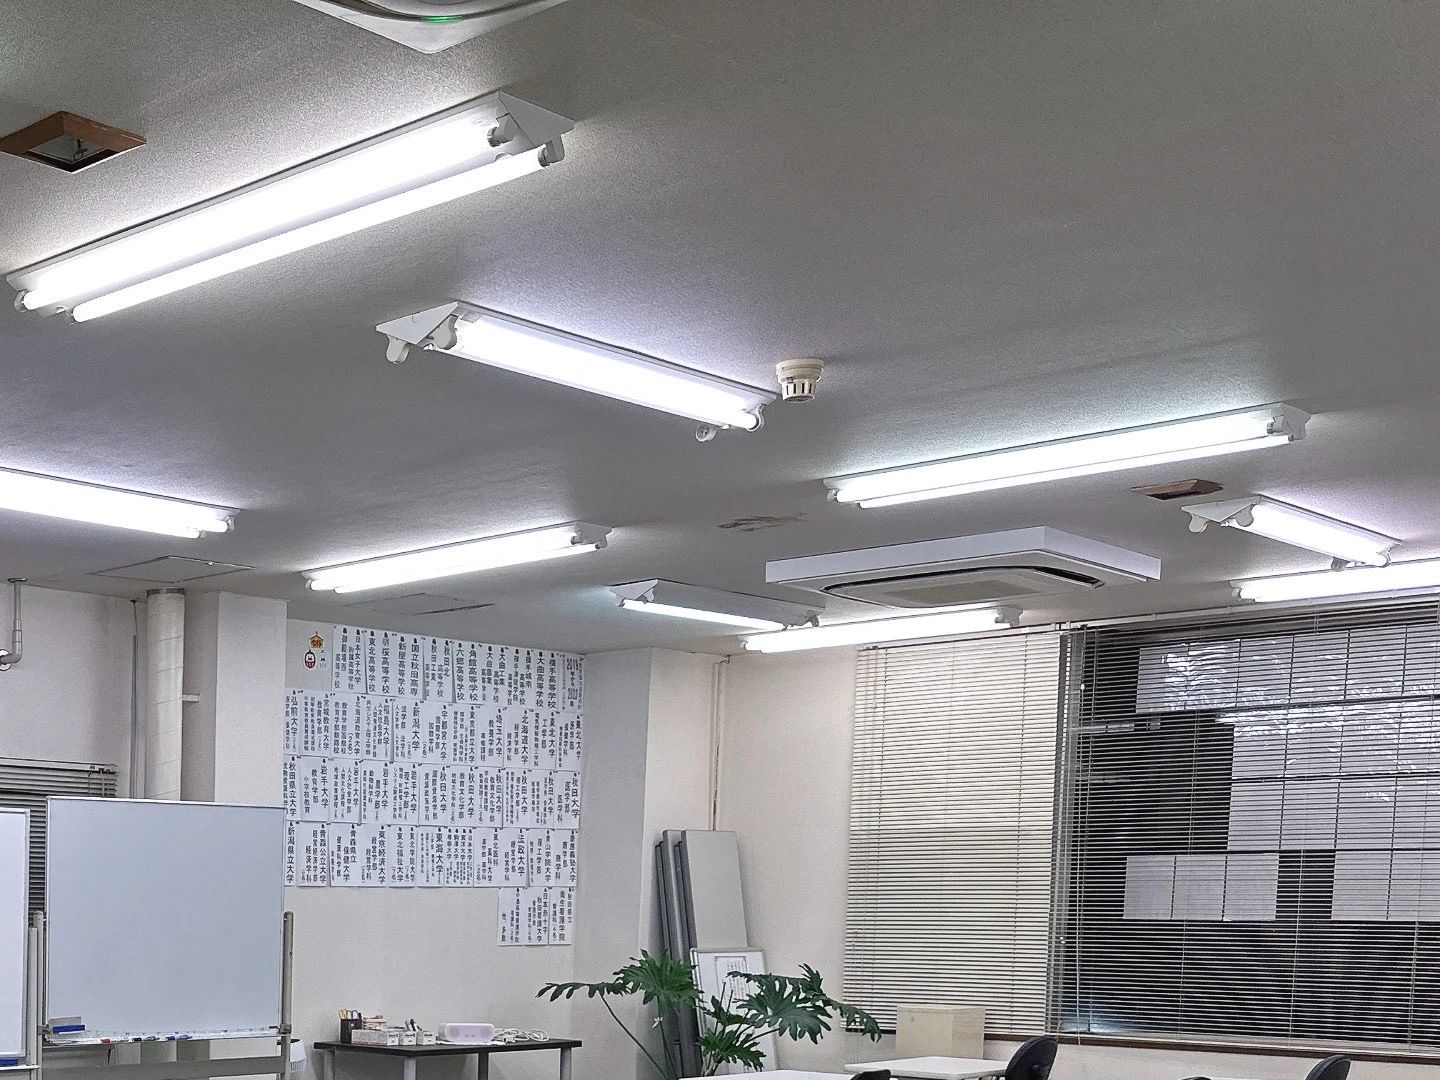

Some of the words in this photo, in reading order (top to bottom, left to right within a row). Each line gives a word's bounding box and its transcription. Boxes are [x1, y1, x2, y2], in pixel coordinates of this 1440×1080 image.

[368, 637, 376, 692] 東北高等学校
[398, 643, 406, 695] 新屋高等学校
[410, 644, 419, 696] 国立秋田高専
[468, 650, 478, 701] 角館高等学校
[536, 658, 544, 707] 大曲高等学校
[547, 659, 556, 708] 横手高等学校
[412, 707, 420, 751] 新潟大学
[321, 765, 329, 808] 岩手大学
[571, 777, 579, 818] 秋田大学
[286, 827, 295, 884] 新潟県立大学
[378, 830, 386, 884] 東京経済大学
[517, 835, 525, 876] 法政大学
